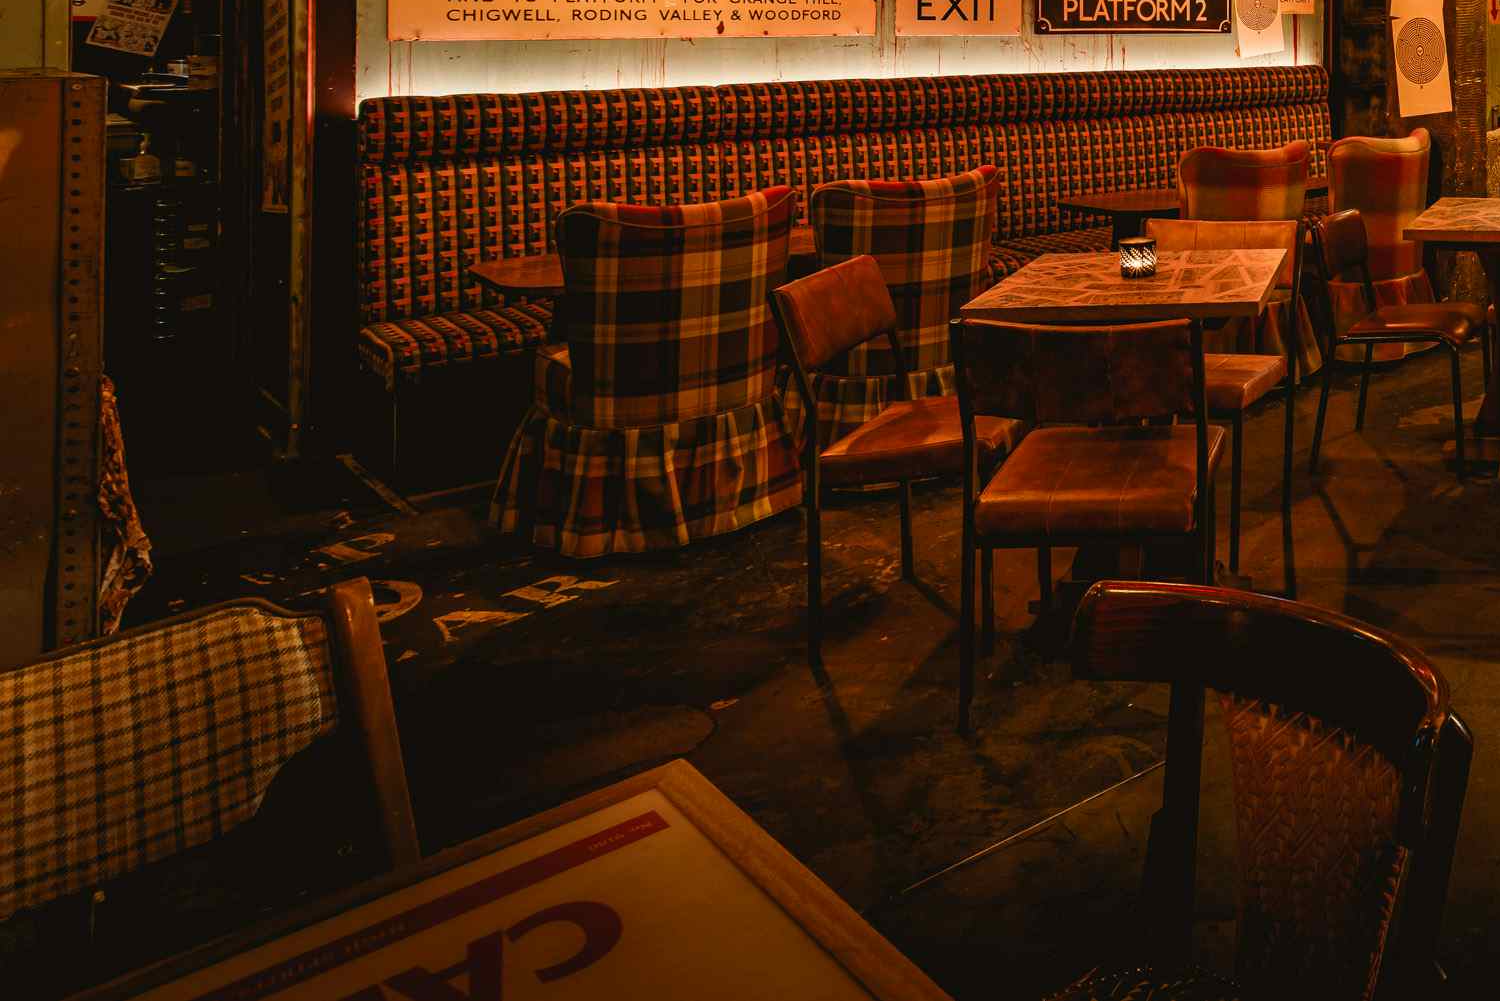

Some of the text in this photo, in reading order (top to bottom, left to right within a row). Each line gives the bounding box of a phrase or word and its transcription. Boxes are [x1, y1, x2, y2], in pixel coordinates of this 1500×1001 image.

[446, 8, 842, 23] CHIGWELL, RODING VALLEY & WOODFORD
